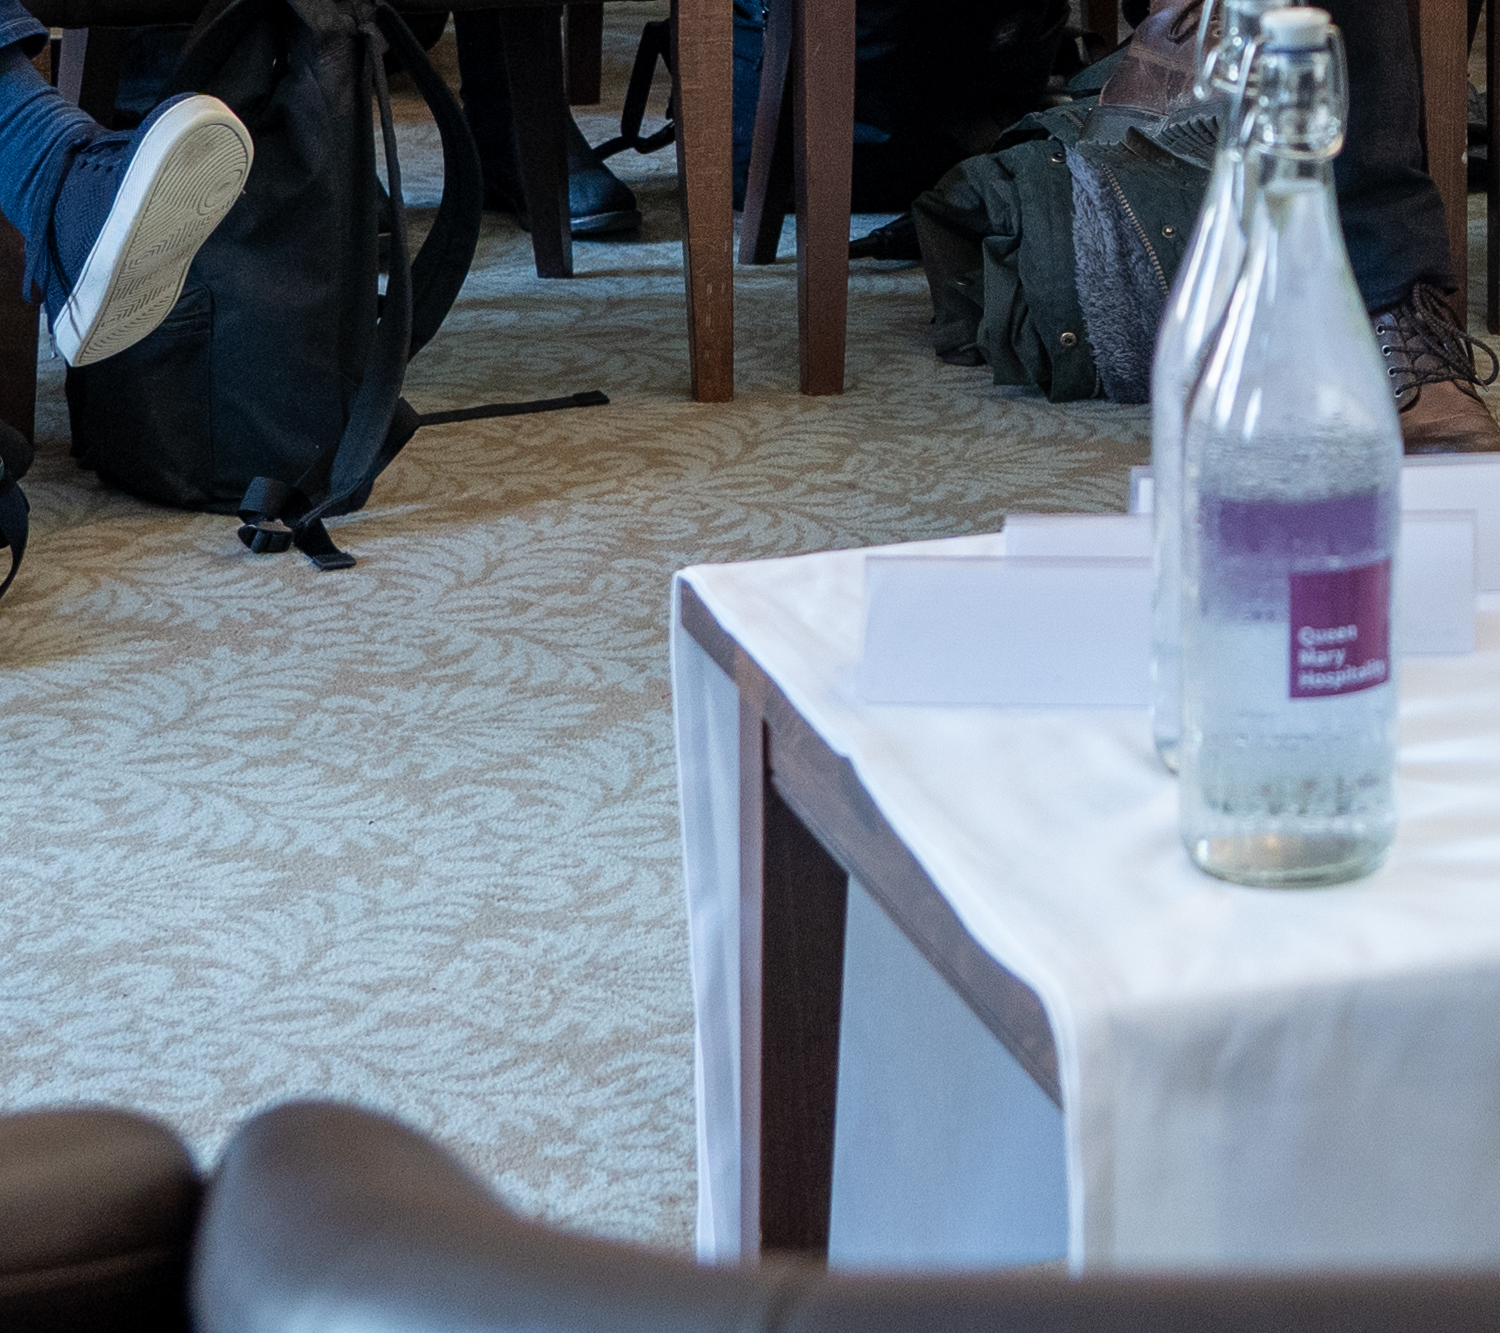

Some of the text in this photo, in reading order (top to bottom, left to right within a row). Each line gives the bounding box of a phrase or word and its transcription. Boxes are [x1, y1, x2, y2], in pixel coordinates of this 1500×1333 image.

[1298, 624, 1358, 648] Queen
[1299, 647, 1346, 668] Mary
[1299, 658, 1385, 690] Hospitality
